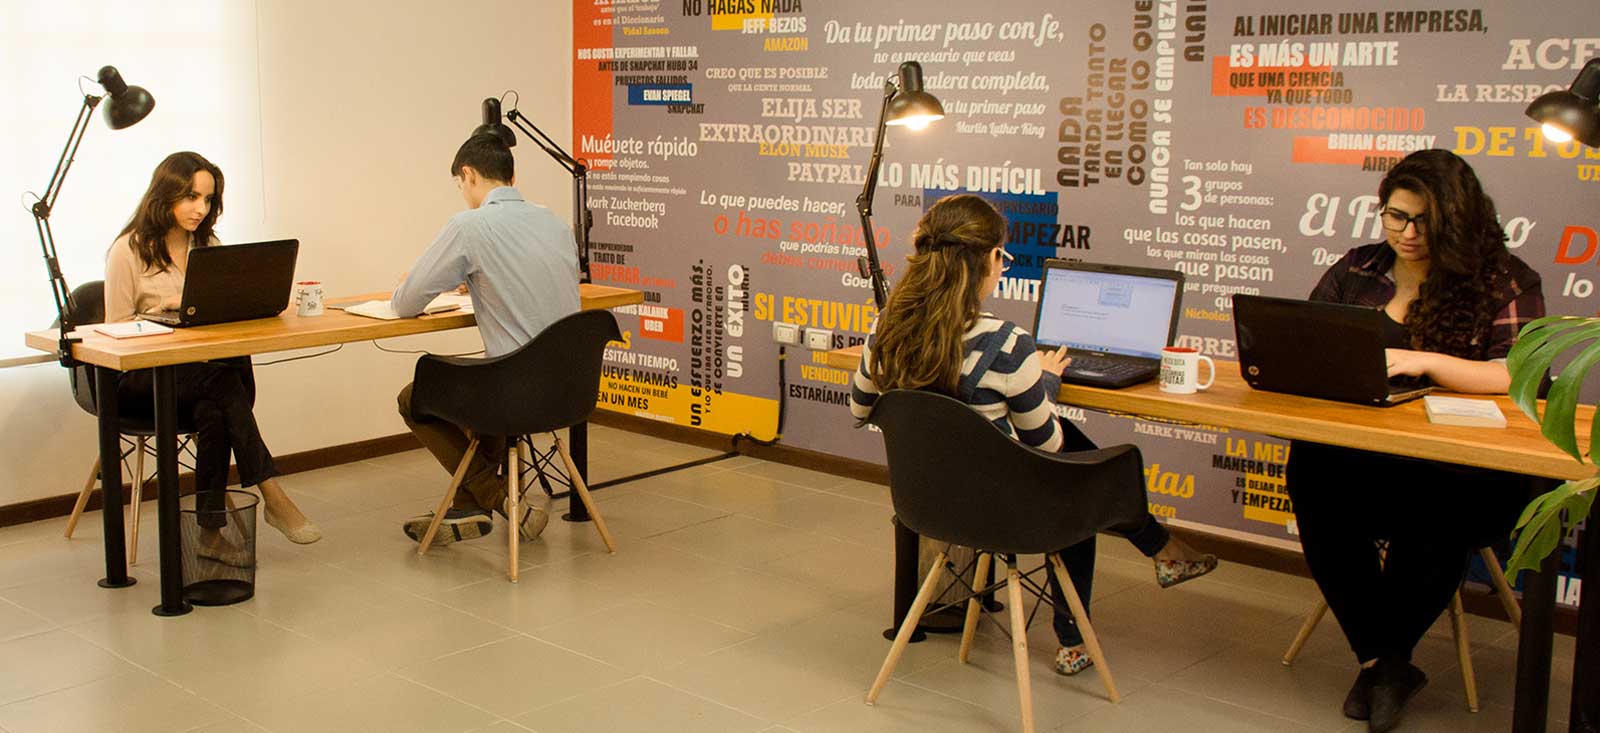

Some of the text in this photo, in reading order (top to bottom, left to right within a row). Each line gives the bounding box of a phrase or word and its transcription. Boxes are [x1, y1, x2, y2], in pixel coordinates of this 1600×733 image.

[682, 0, 803, 16] NO HAGAS NADA
[742, 17, 807, 34] JEFF BEZOS
[823, 12, 1065, 49] Da tu primer paso con fe,
[1234, 9, 1488, 37] AL INICIAR UNA EMPRESA,
[764, 37, 808, 52] AMAZON
[1229, 38, 1399, 68] ES MÁS UN ARTE
[599, 61, 619, 71] ANTES
[620, 61, 628, 71] DE
[629, 61, 664, 71] SNAPCHAT
[687, 60, 698, 71] 34
[873, 51, 888, 63] no
[962, 50, 986, 66] que
[987, 50, 1015, 62] veas
[705, 66, 829, 81] CREO QUE ES POSIBLE
[850, 72, 884, 90] toda
[971, 70, 1050, 95] completa,
[1229, 71, 1344, 89] QUE UNA CIENCIA
[643, 89, 691, 102] EVAN SPIEGEL
[728, 83, 742, 93] QUE
[1127, 0, 1153, 186] COMO LO QUE
[1266, 89, 1353, 105] YA QUE TODO
[1436, 84, 1470, 102] LA
[667, 103, 705, 115] SNAPCHAT
[761, 98, 863, 123] ELIJA SER
[955, 99, 1047, 119] tu primer paso
[1083, 23, 1107, 188] TARDA TANTO
[1104, 57, 1128, 178] EN LLEGAR
[1244, 106, 1425, 131] ES DESCONOCIDO
[581, 133, 698, 161] Muévete rápido
[759, 144, 851, 159] ELON MUSK
[1056, 97, 1083, 188] NADA
[1327, 133, 1436, 152] BRIAN CHESKY
[1452, 126, 1517, 157] DE
[1149, 99, 1172, 215] NUNCA SE
[1183, 159, 1252, 175] Tan solo hay
[788, 162, 868, 185] PAYPAL
[877, 157, 1046, 196] LO MÁS DIFÍCIL
[1180, 175, 1202, 211] 3
[1204, 180, 1243, 193] grupos
[611, 196, 667, 217] Zuckerberg
[700, 190, 847, 217] Lo que puedes hacer,
[894, 194, 921, 208] PARA
[1204, 192, 1275, 206] de personas:
[607, 211, 659, 229] Facebook
[1175, 211, 1271, 231] los que hacen
[1298, 192, 1341, 237] El
[714, 210, 782, 240] o has
[779, 240, 839, 255] que podrías
[1123, 226, 1287, 253] que las cosas pasen,
[594, 252, 625, 265] TRATO DE
[1147, 245, 1269, 266] los que miran las cosas
[1214, 263, 1273, 282] pasan
[1202, 283, 1260, 297] preguntan
[1562, 272, 1595, 298] lo
[753, 292, 775, 321] SI
[724, 263, 744, 378] UN ÉXITO
[637, 353, 680, 371] TIEMPO.
[632, 370, 678, 389] MAMÁS
[801, 364, 849, 386] VENDIDO
[608, 381, 669, 399] NO HACEN UN BEBÉ
[611, 393, 649, 410] UN MES
[1134, 422, 1218, 444] MARK TWAIN
[1225, 436, 1248, 460] LA
[1211, 454, 1284, 479] MANERA DE
[1231, 488, 1240, 504] Y
[1248, 479, 1275, 493] DEJAR
